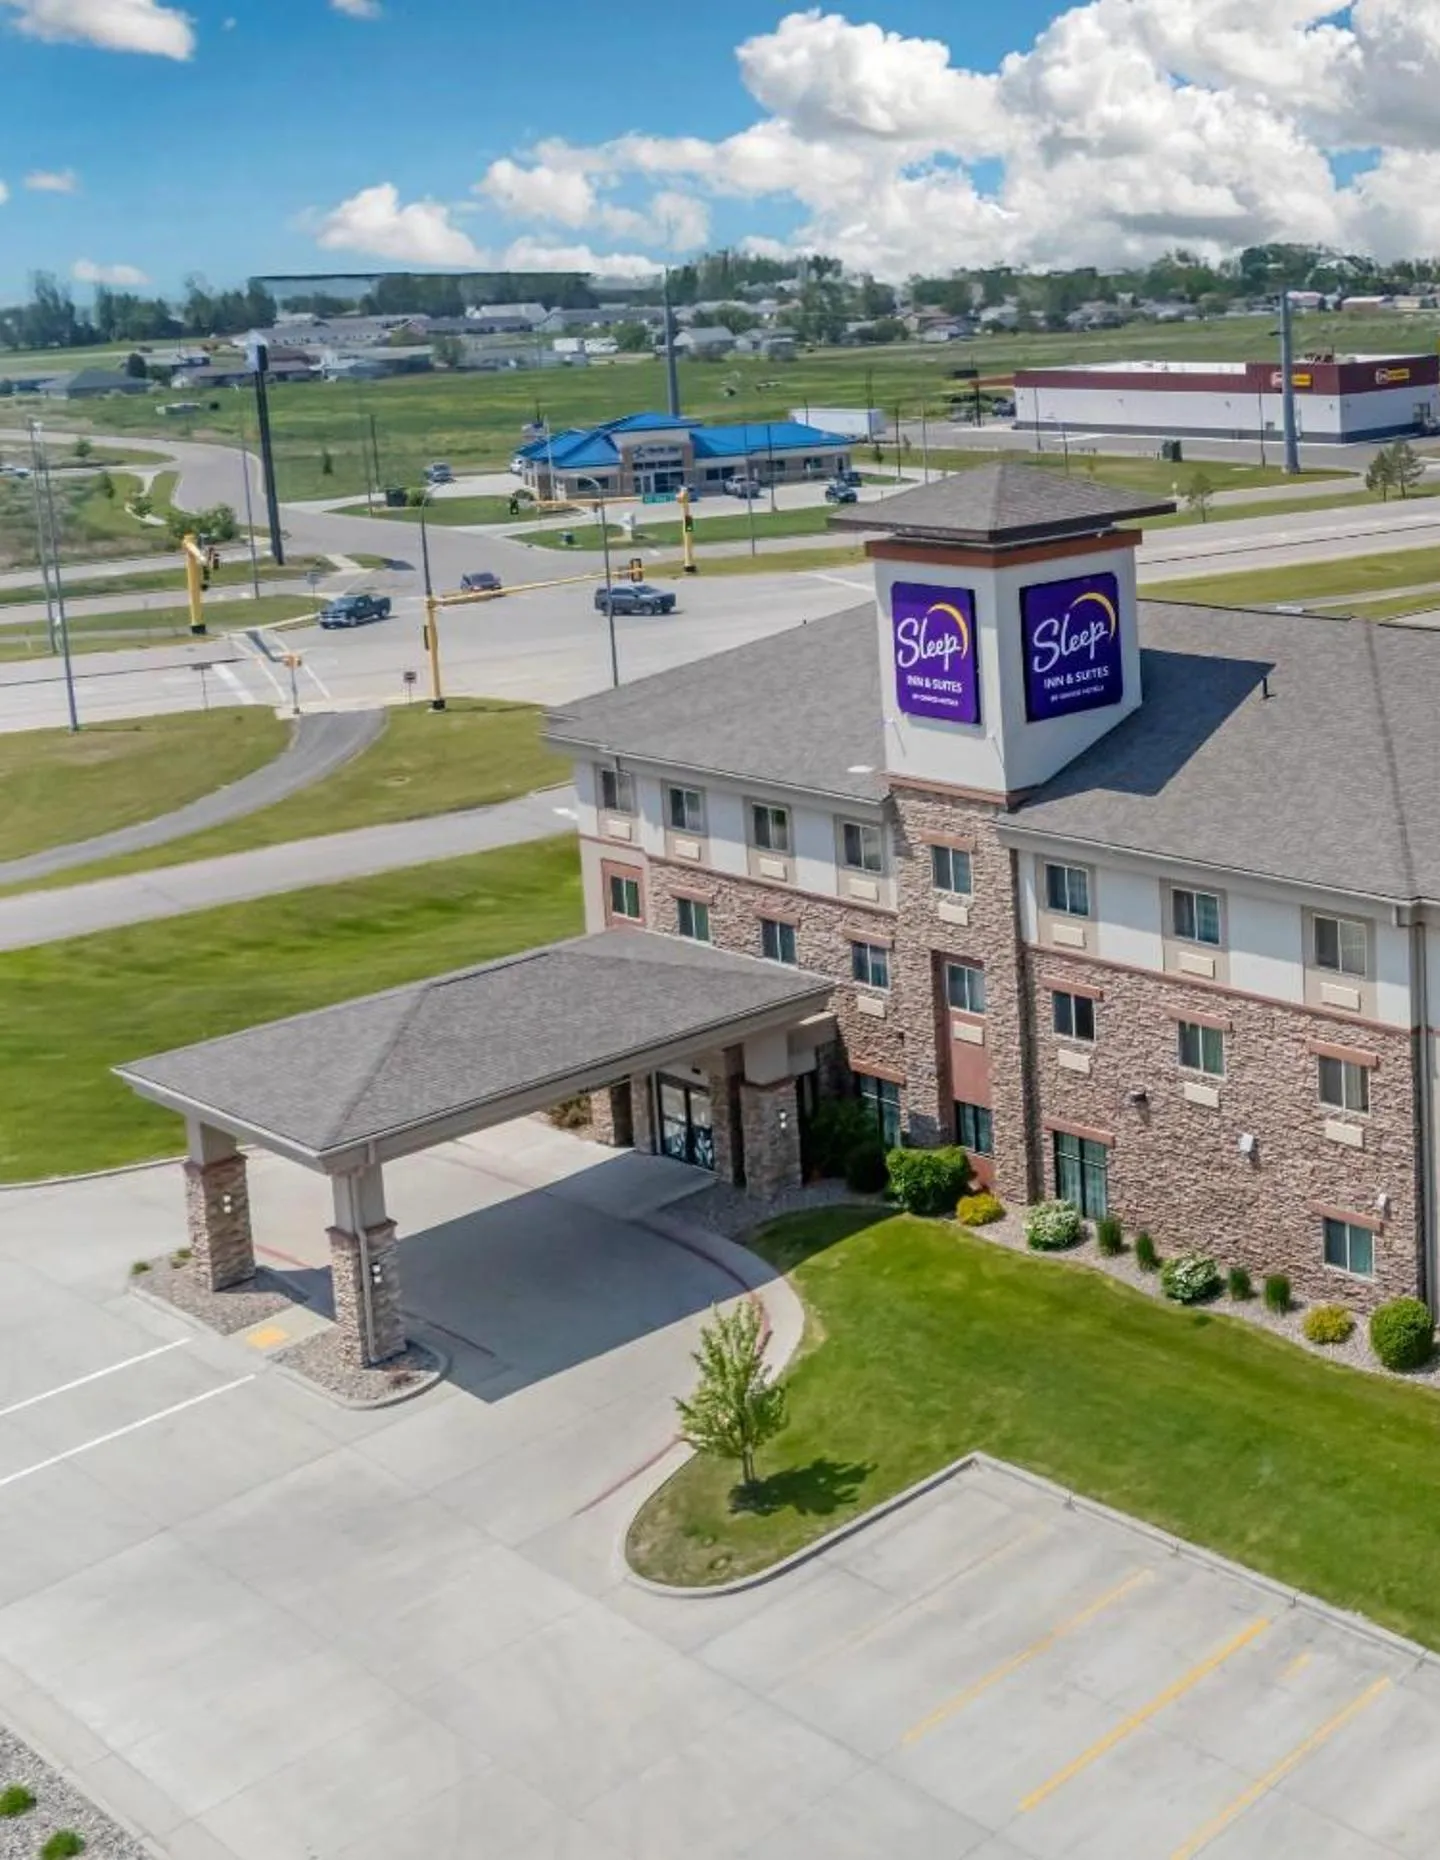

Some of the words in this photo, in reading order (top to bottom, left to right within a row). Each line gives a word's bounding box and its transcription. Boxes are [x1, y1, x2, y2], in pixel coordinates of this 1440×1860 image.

[897, 616, 962, 672] Sleep
[1032, 613, 1109, 674] Sleep
[906, 674, 924, 688] INN
[932, 678, 963, 694] SUITES
[1043, 675, 1064, 690] INN
[1066, 672, 1074, 685] &
[1075, 664, 1109, 683] SUITES
